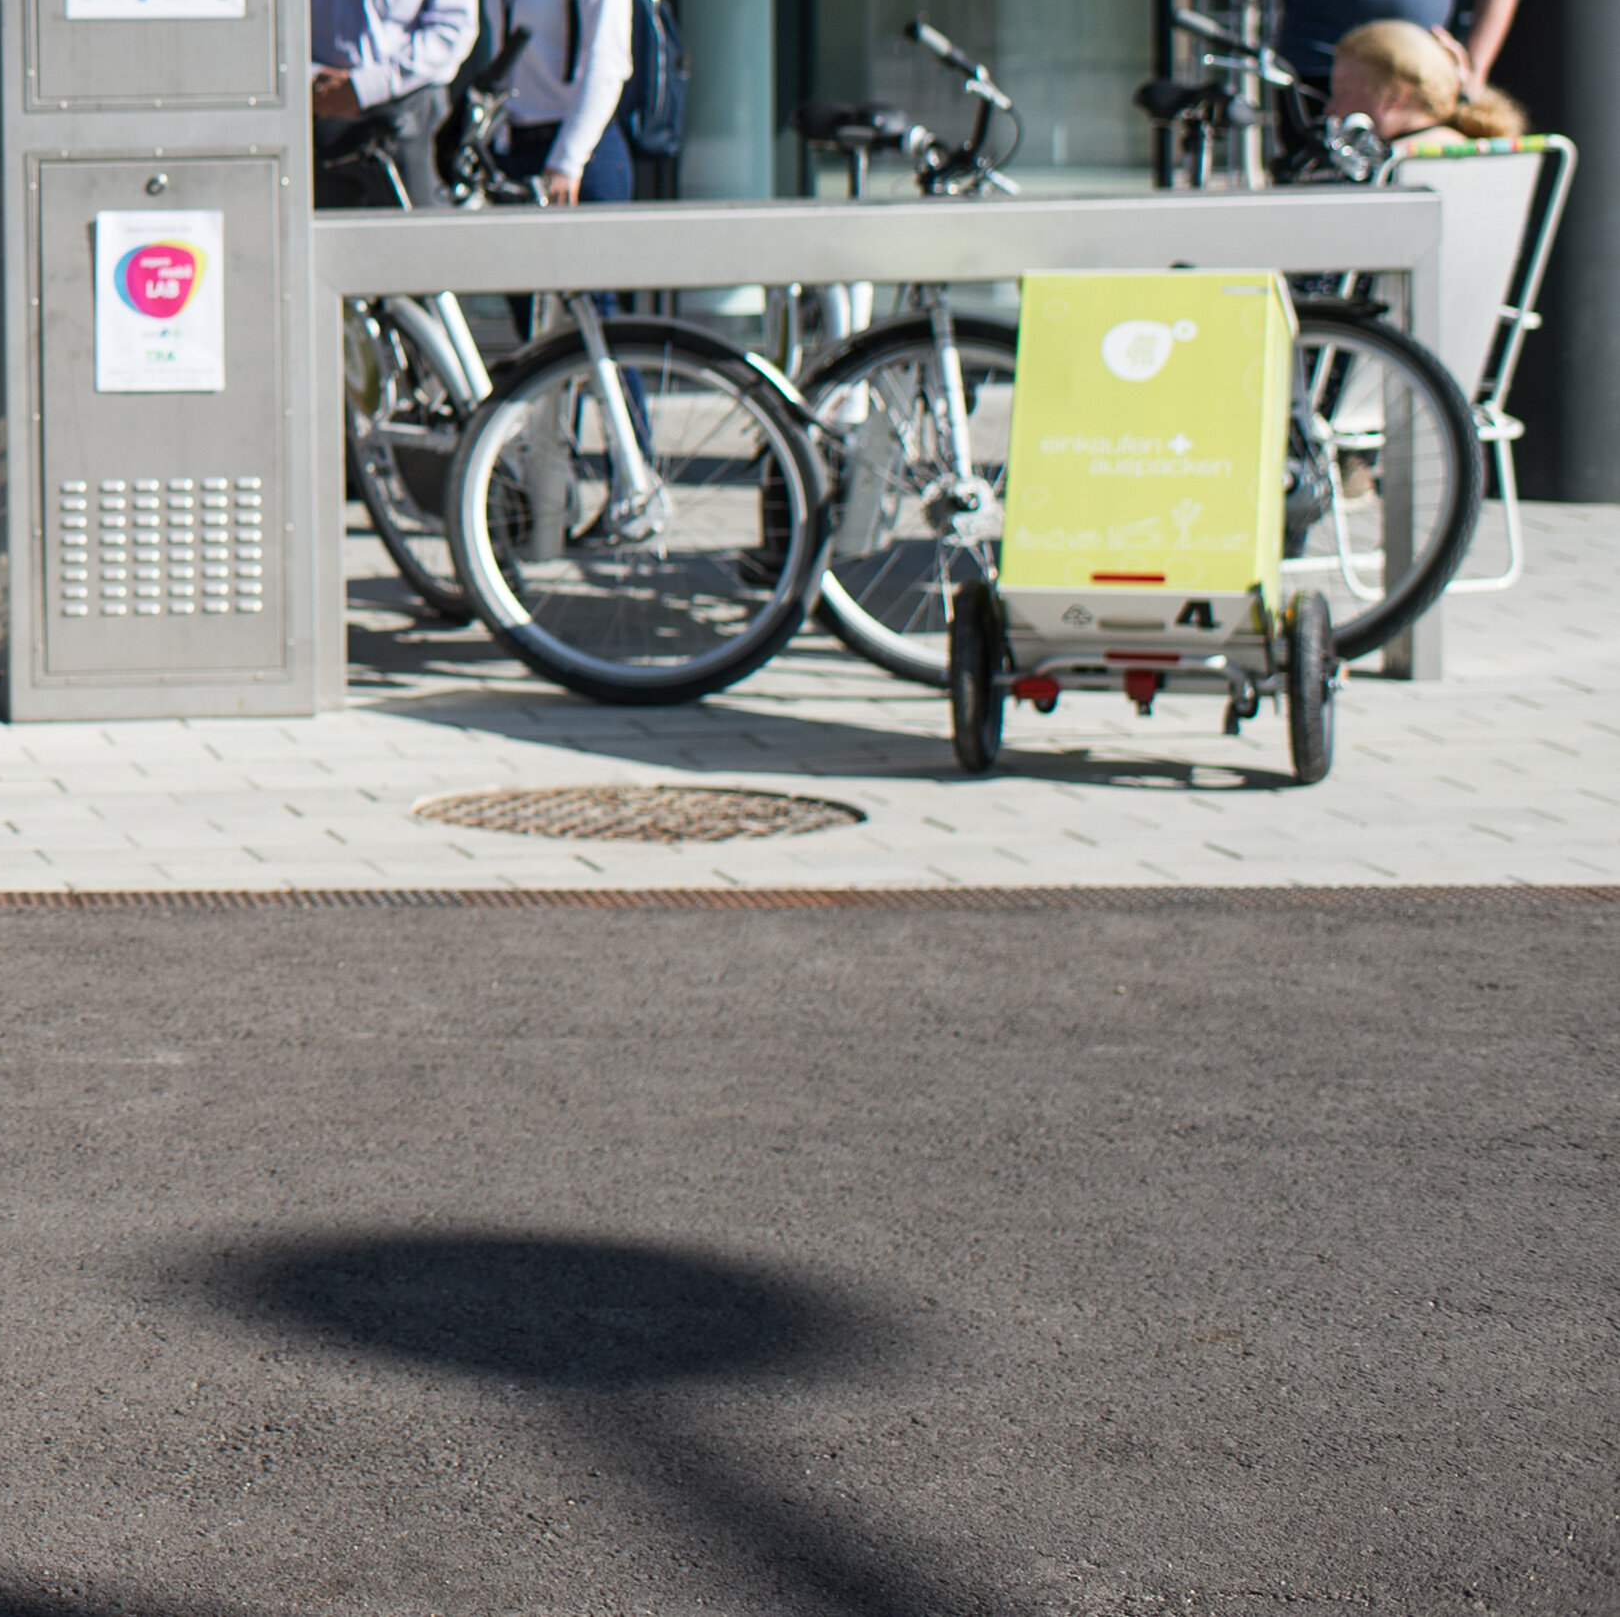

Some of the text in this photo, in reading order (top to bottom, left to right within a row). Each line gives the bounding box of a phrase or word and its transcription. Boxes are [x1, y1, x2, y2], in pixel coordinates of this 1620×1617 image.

[145, 279, 180, 299] LAB
[1039, 434, 1162, 455] einkaufen
[1088, 456, 1232, 478] auspacken
